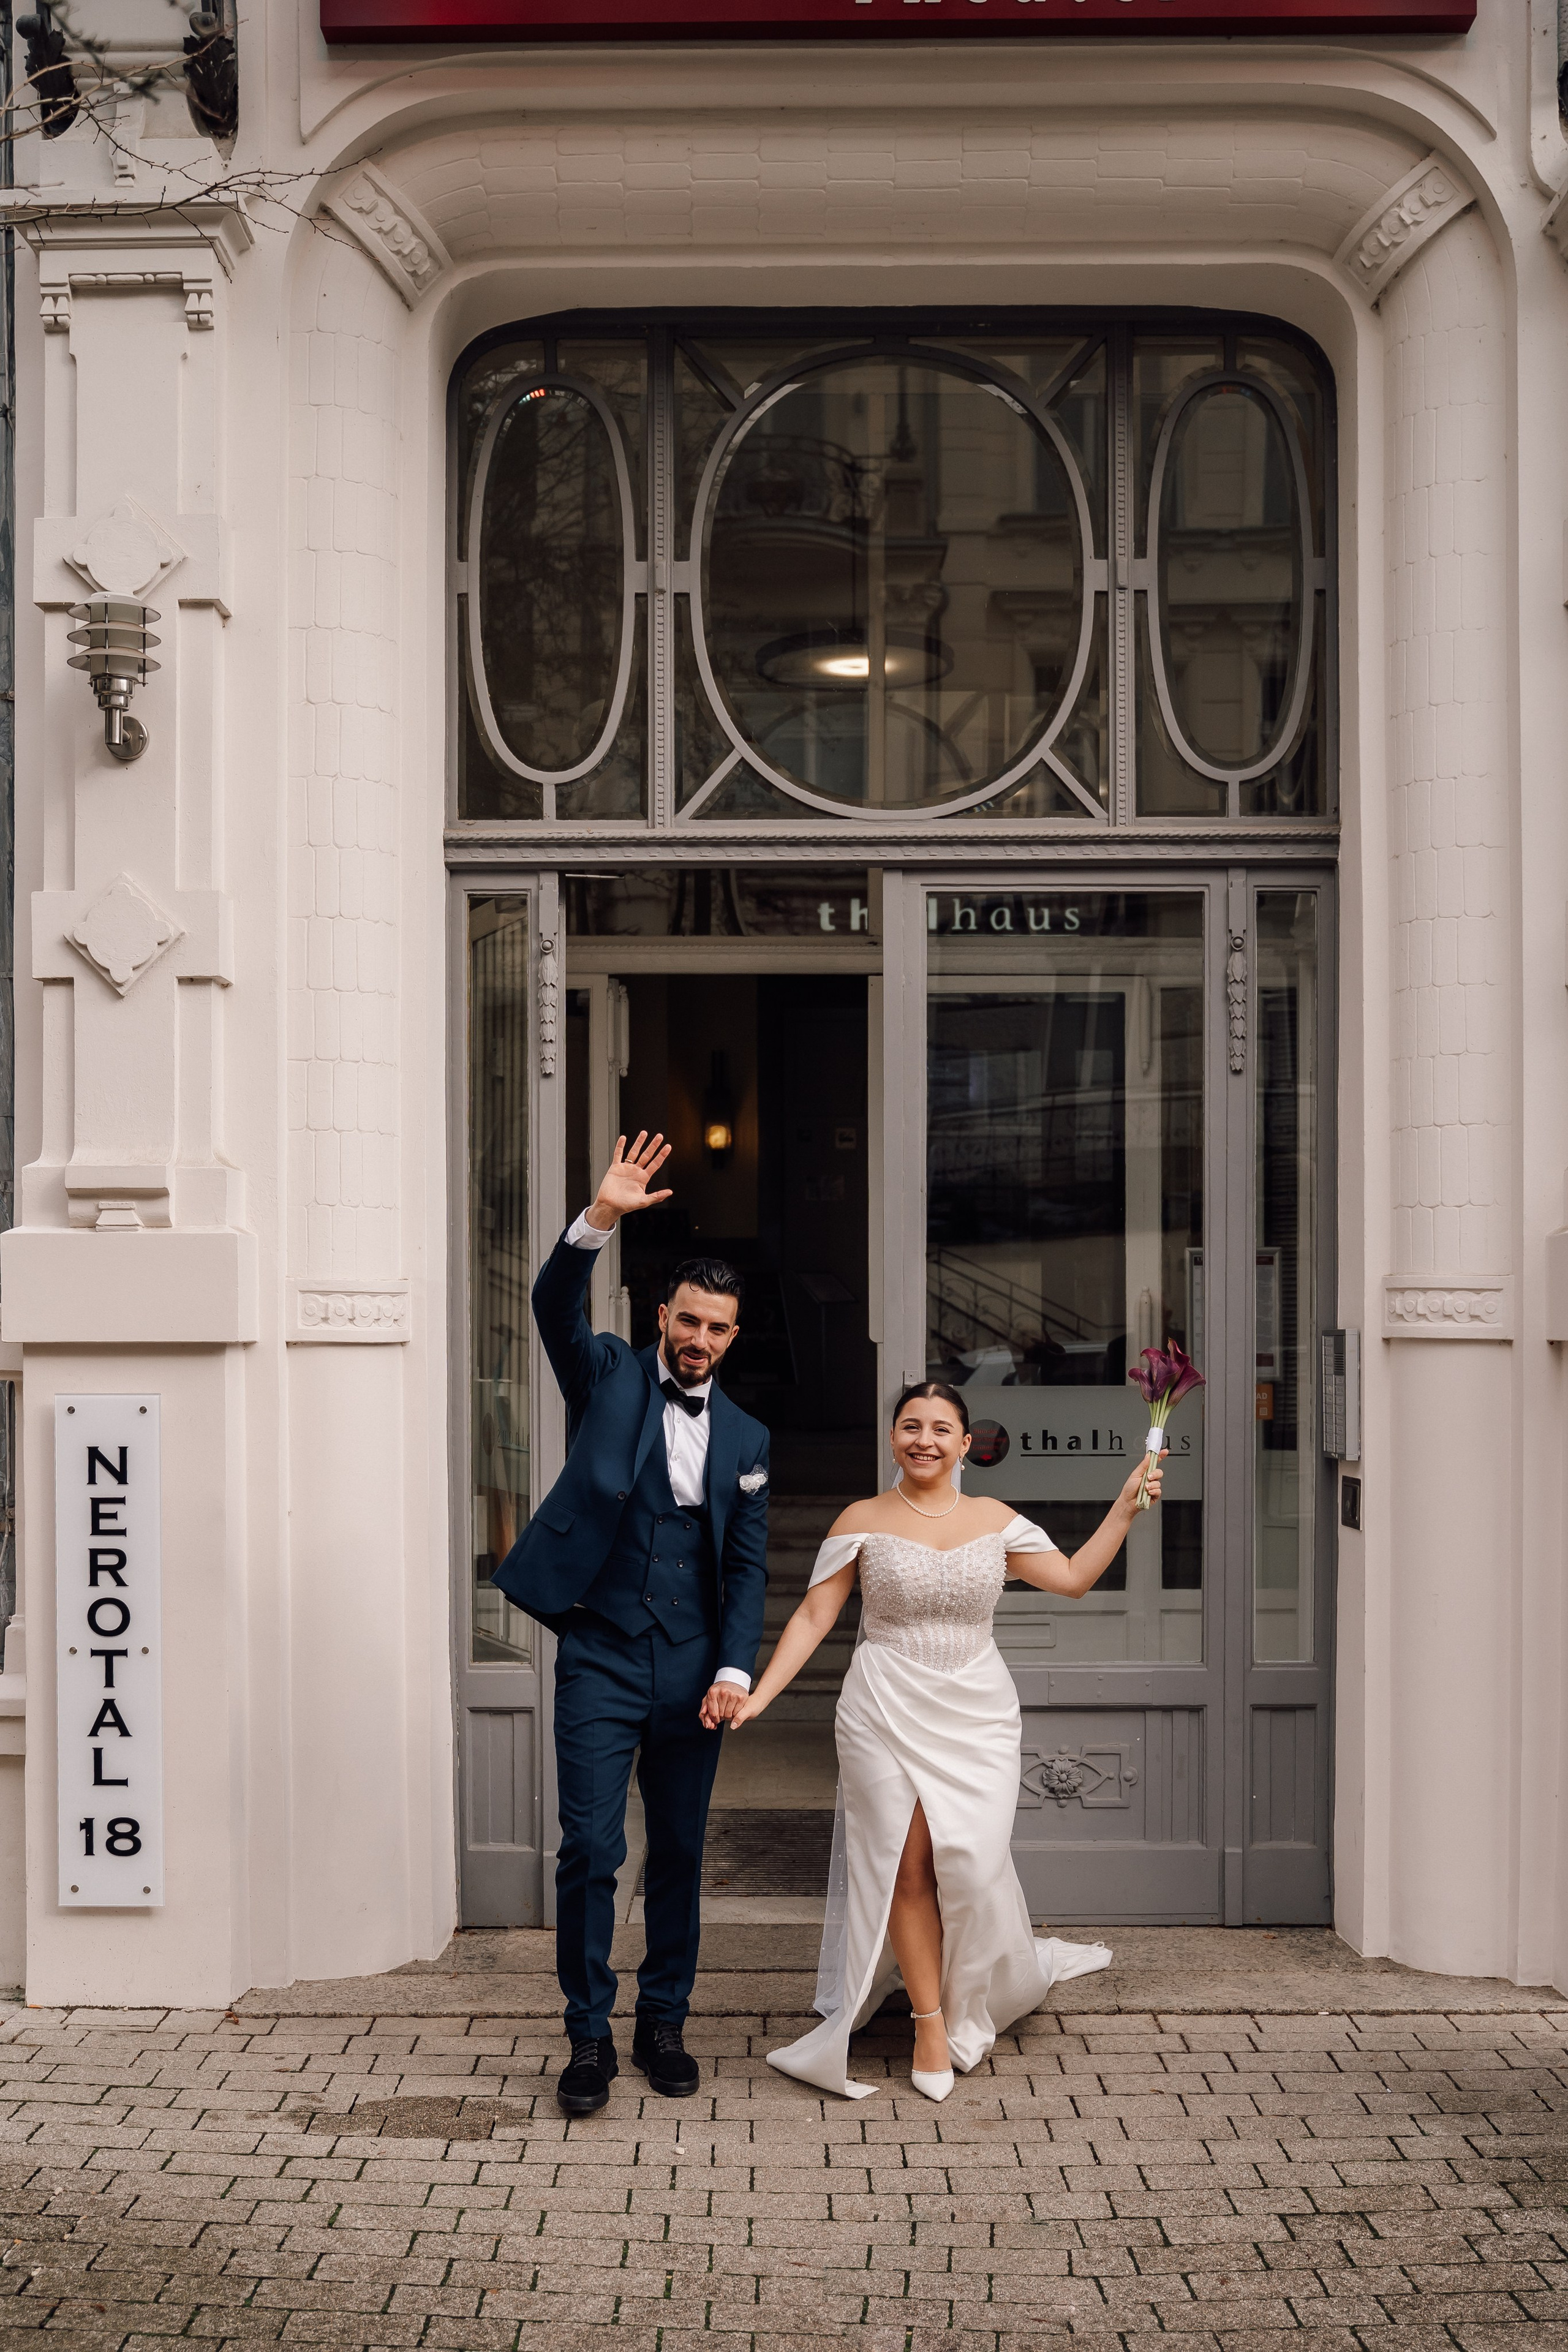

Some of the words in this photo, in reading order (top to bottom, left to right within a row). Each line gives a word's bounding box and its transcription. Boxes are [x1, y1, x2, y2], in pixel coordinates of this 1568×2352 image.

[817, 898, 1080, 930] thlhaus
[1020, 1430, 1191, 1450] thalhus
[86, 1446, 132, 1787] NEROTAL
[80, 1817, 141, 1856] 18
